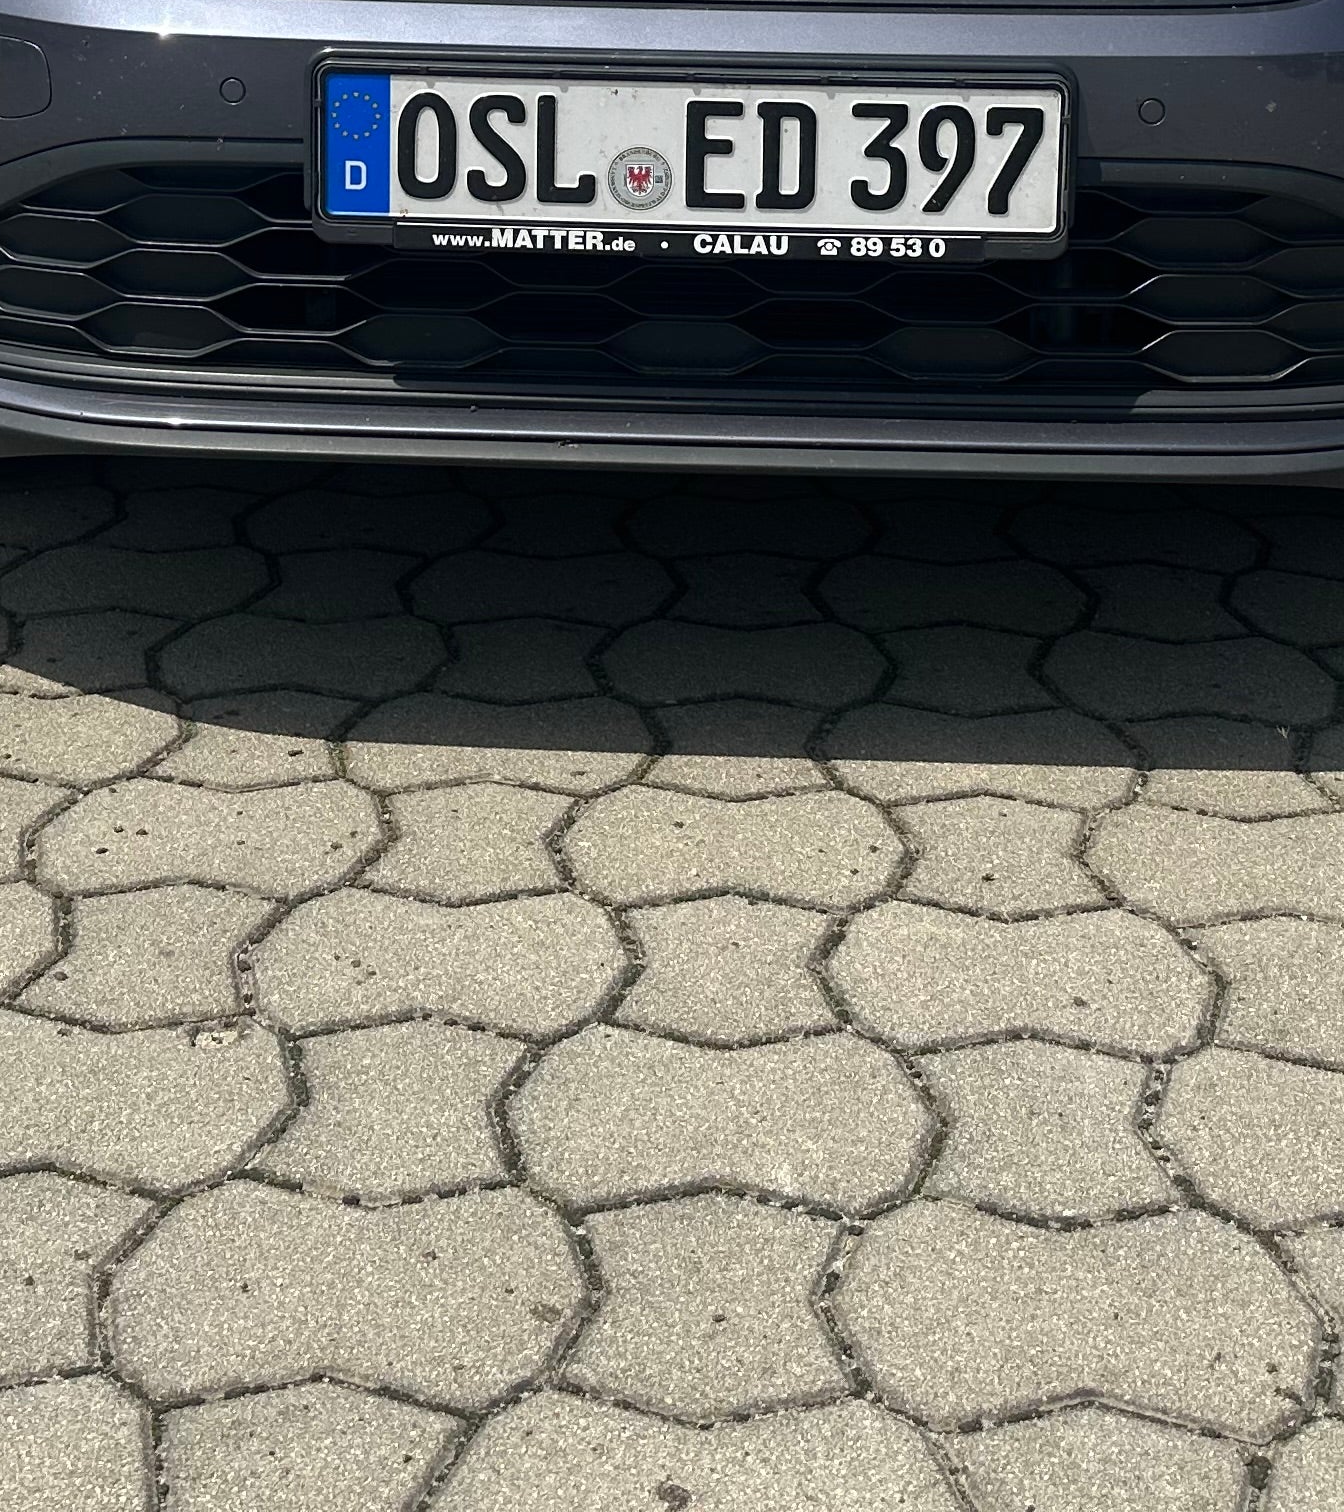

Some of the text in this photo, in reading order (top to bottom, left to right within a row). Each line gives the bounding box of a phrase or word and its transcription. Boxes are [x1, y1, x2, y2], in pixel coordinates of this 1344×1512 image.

[397, 91, 1045, 215] OSL ED 397
[344, 160, 367, 191] D
[432, 228, 946, 258] www.MATTER.de CALAU 89 53 0
